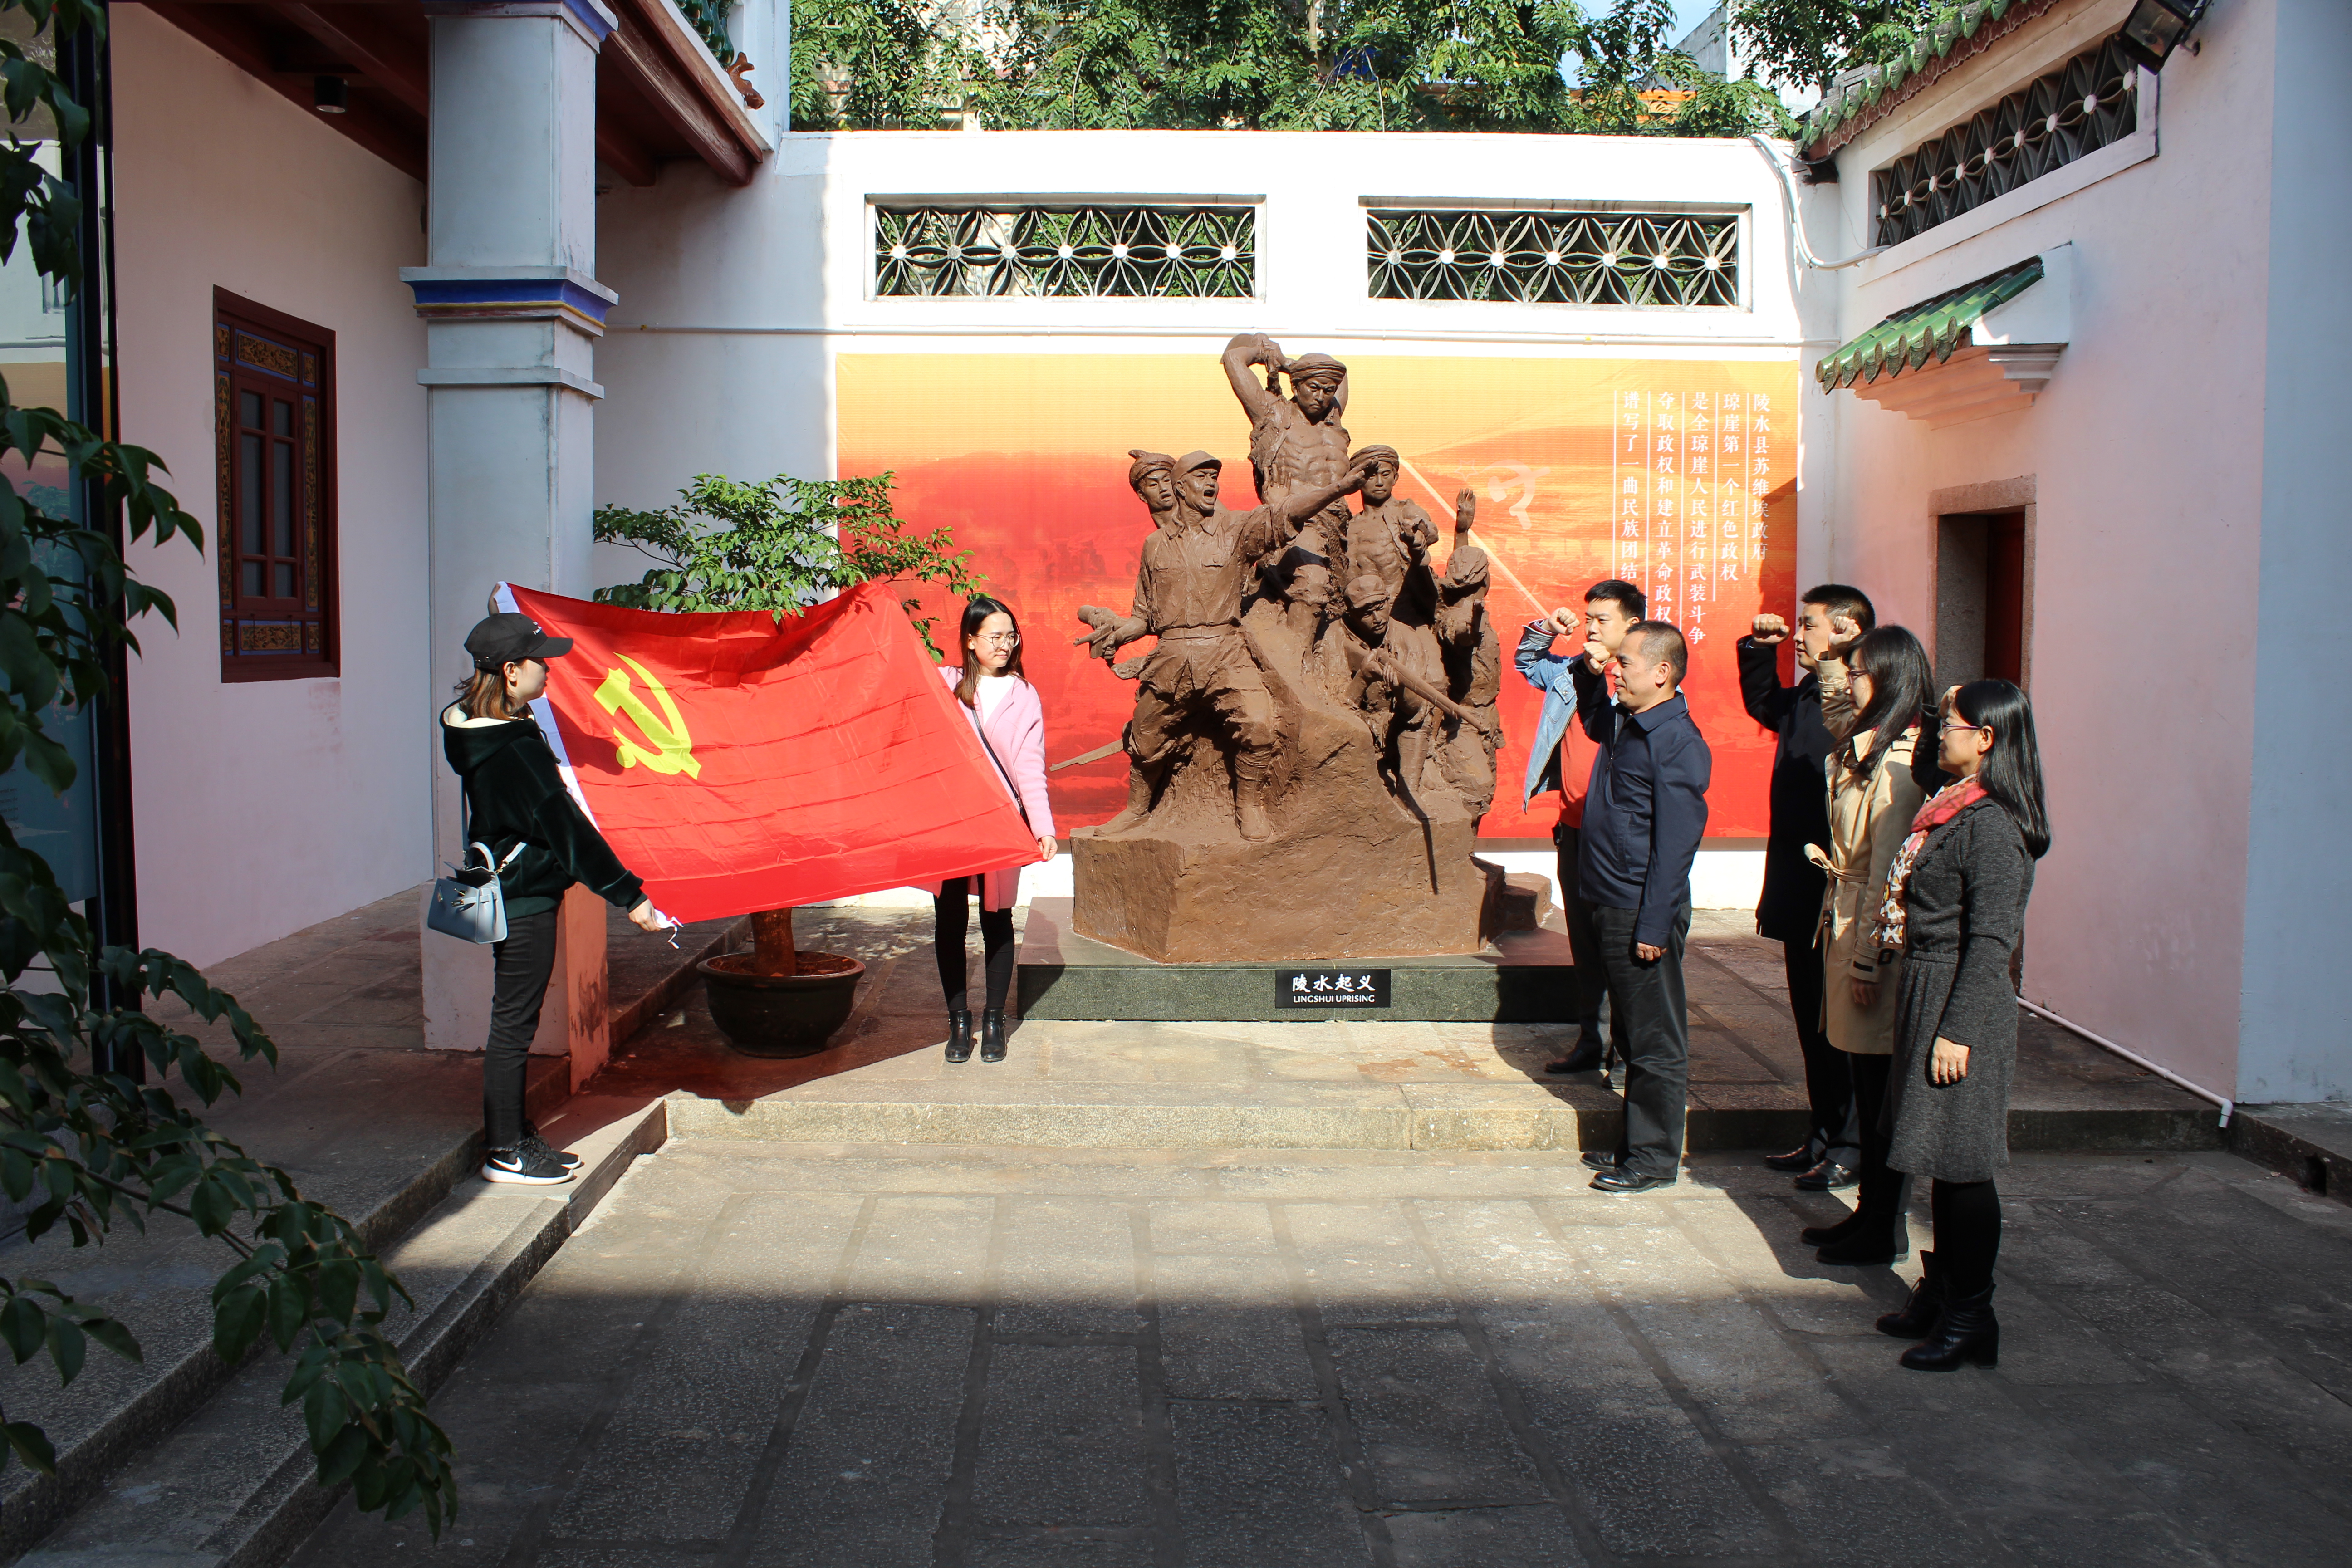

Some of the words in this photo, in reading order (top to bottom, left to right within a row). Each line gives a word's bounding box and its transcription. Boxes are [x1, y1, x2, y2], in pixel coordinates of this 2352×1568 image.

[1621, 391, 1640, 580] 谱写了一曲民族团结
[1654, 391, 1675, 623] 夺取政权和建立革命政权
[1688, 392, 1710, 645] 是全琼崖人民进行武装斗争
[1720, 392, 1740, 581] 琼崖第一个红色政权
[1750, 393, 1771, 560] 陵水县苏维埃政府
[1292, 974, 1376, 993] 陵水起义
[1294, 995, 1334, 1003] LINGSHUI
[1335, 995, 1375, 1003] UPRISING
